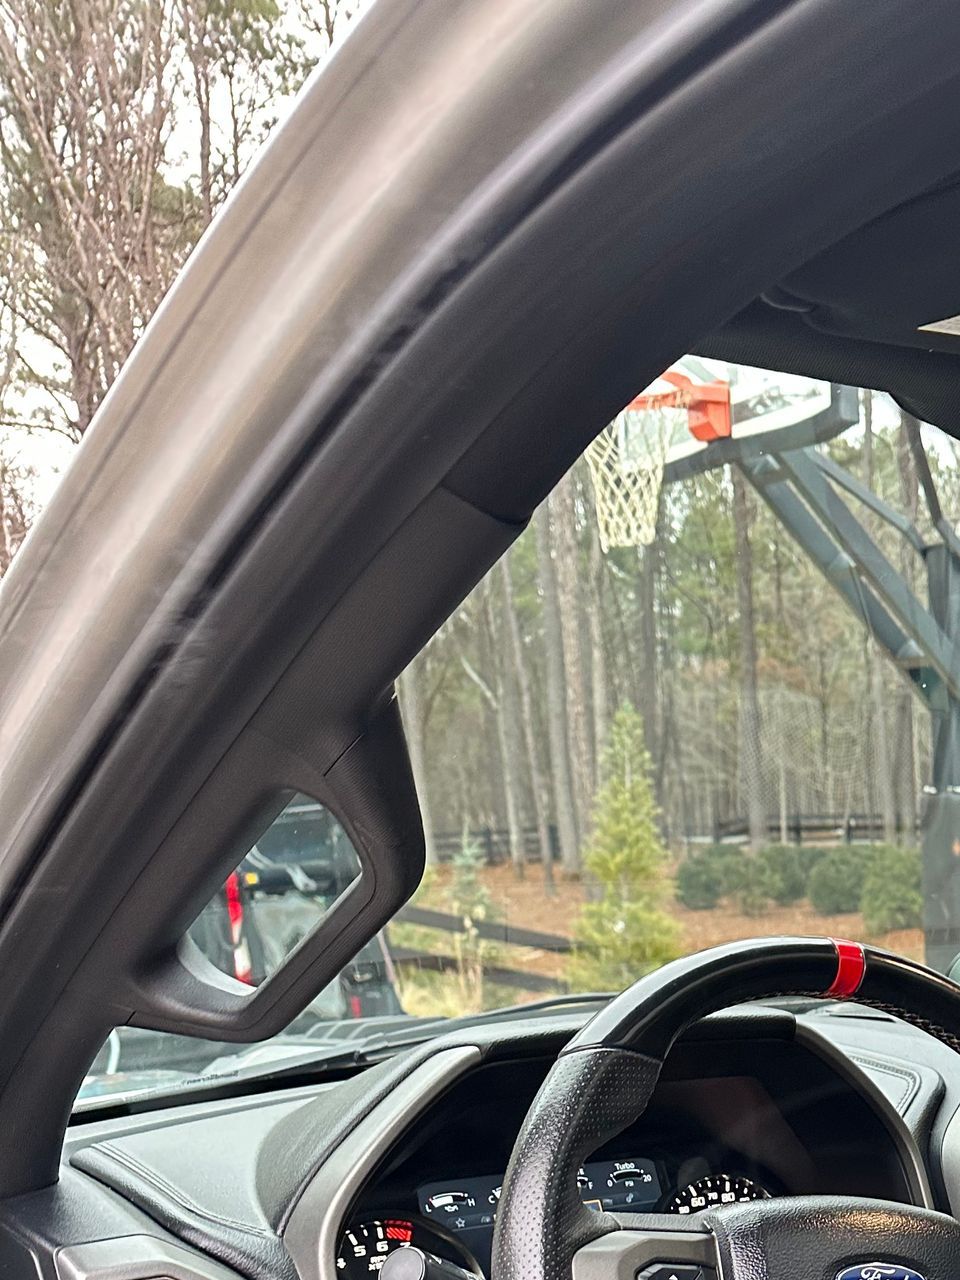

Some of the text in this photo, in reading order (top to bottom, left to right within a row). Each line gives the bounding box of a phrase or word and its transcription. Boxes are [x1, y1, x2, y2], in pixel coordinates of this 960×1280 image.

[614, 1162, 636, 1171] Turbo
[642, 1173, 652, 1183] 20
[707, 1191, 719, 1201] 70
[690, 1196, 706, 1208] 60
[353, 1244, 367, 1257] 5
[376, 1240, 389, 1252] 6
